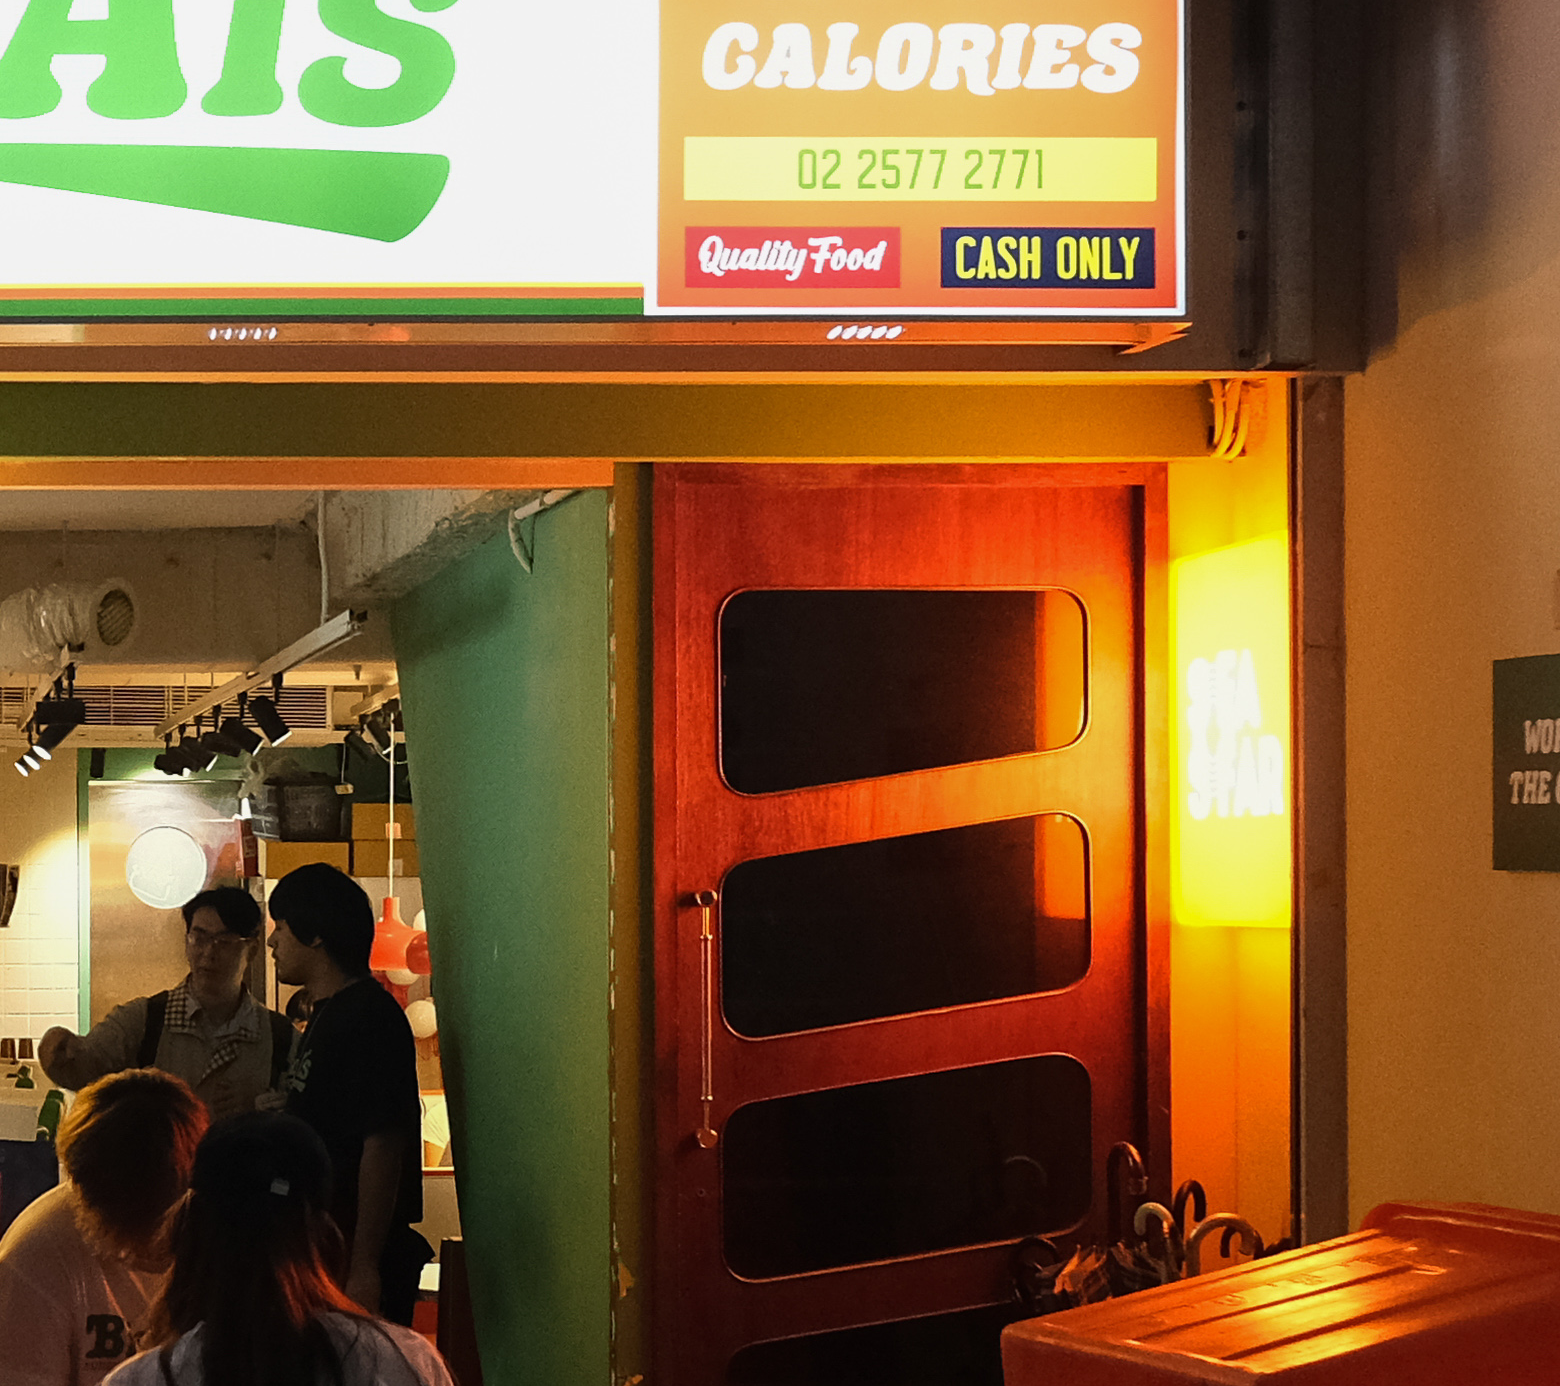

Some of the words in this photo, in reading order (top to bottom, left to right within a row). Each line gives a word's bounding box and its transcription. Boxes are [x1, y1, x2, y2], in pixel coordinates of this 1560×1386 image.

[701, 22, 1143, 96] CALORIES
[797, 149, 841, 190] 02
[857, 149, 947, 190] 2577
[963, 149, 1045, 190] 2771
[698, 235, 808, 281] Quality
[807, 235, 888, 274] Food
[955, 235, 1042, 281] CASH
[1055, 235, 1141, 281] ONLY
[1509, 770, 1552, 805] THE
